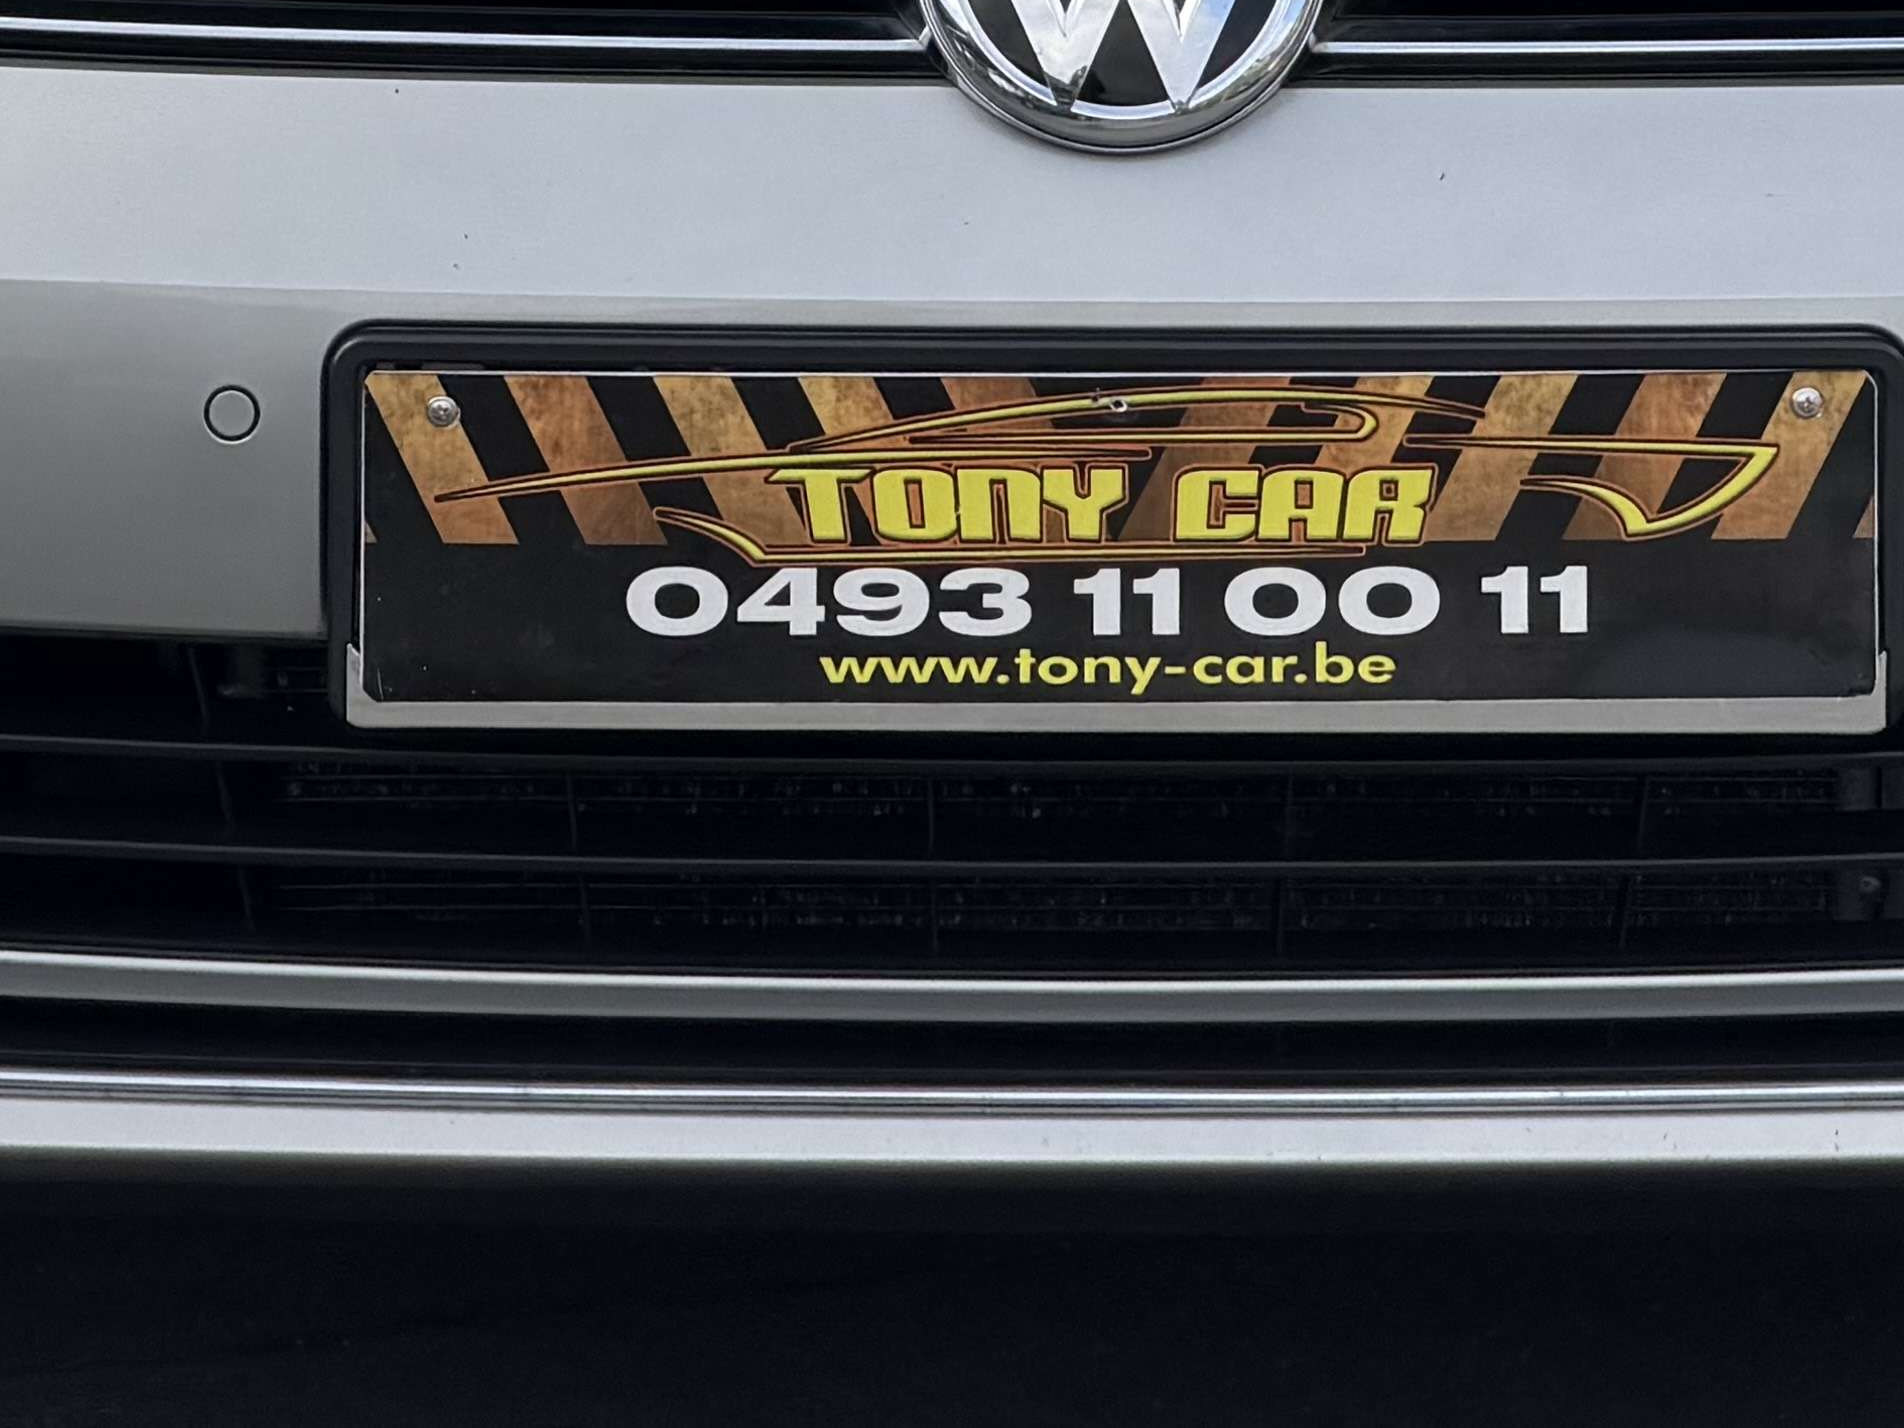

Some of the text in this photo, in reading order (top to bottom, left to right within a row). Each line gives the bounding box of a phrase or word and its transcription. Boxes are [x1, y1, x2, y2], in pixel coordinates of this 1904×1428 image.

[768, 467, 1435, 543] TONY CAR
[625, 565, 1589, 637] 0493 11 00 11
[819, 641, 1397, 696] www.tony-car.be
